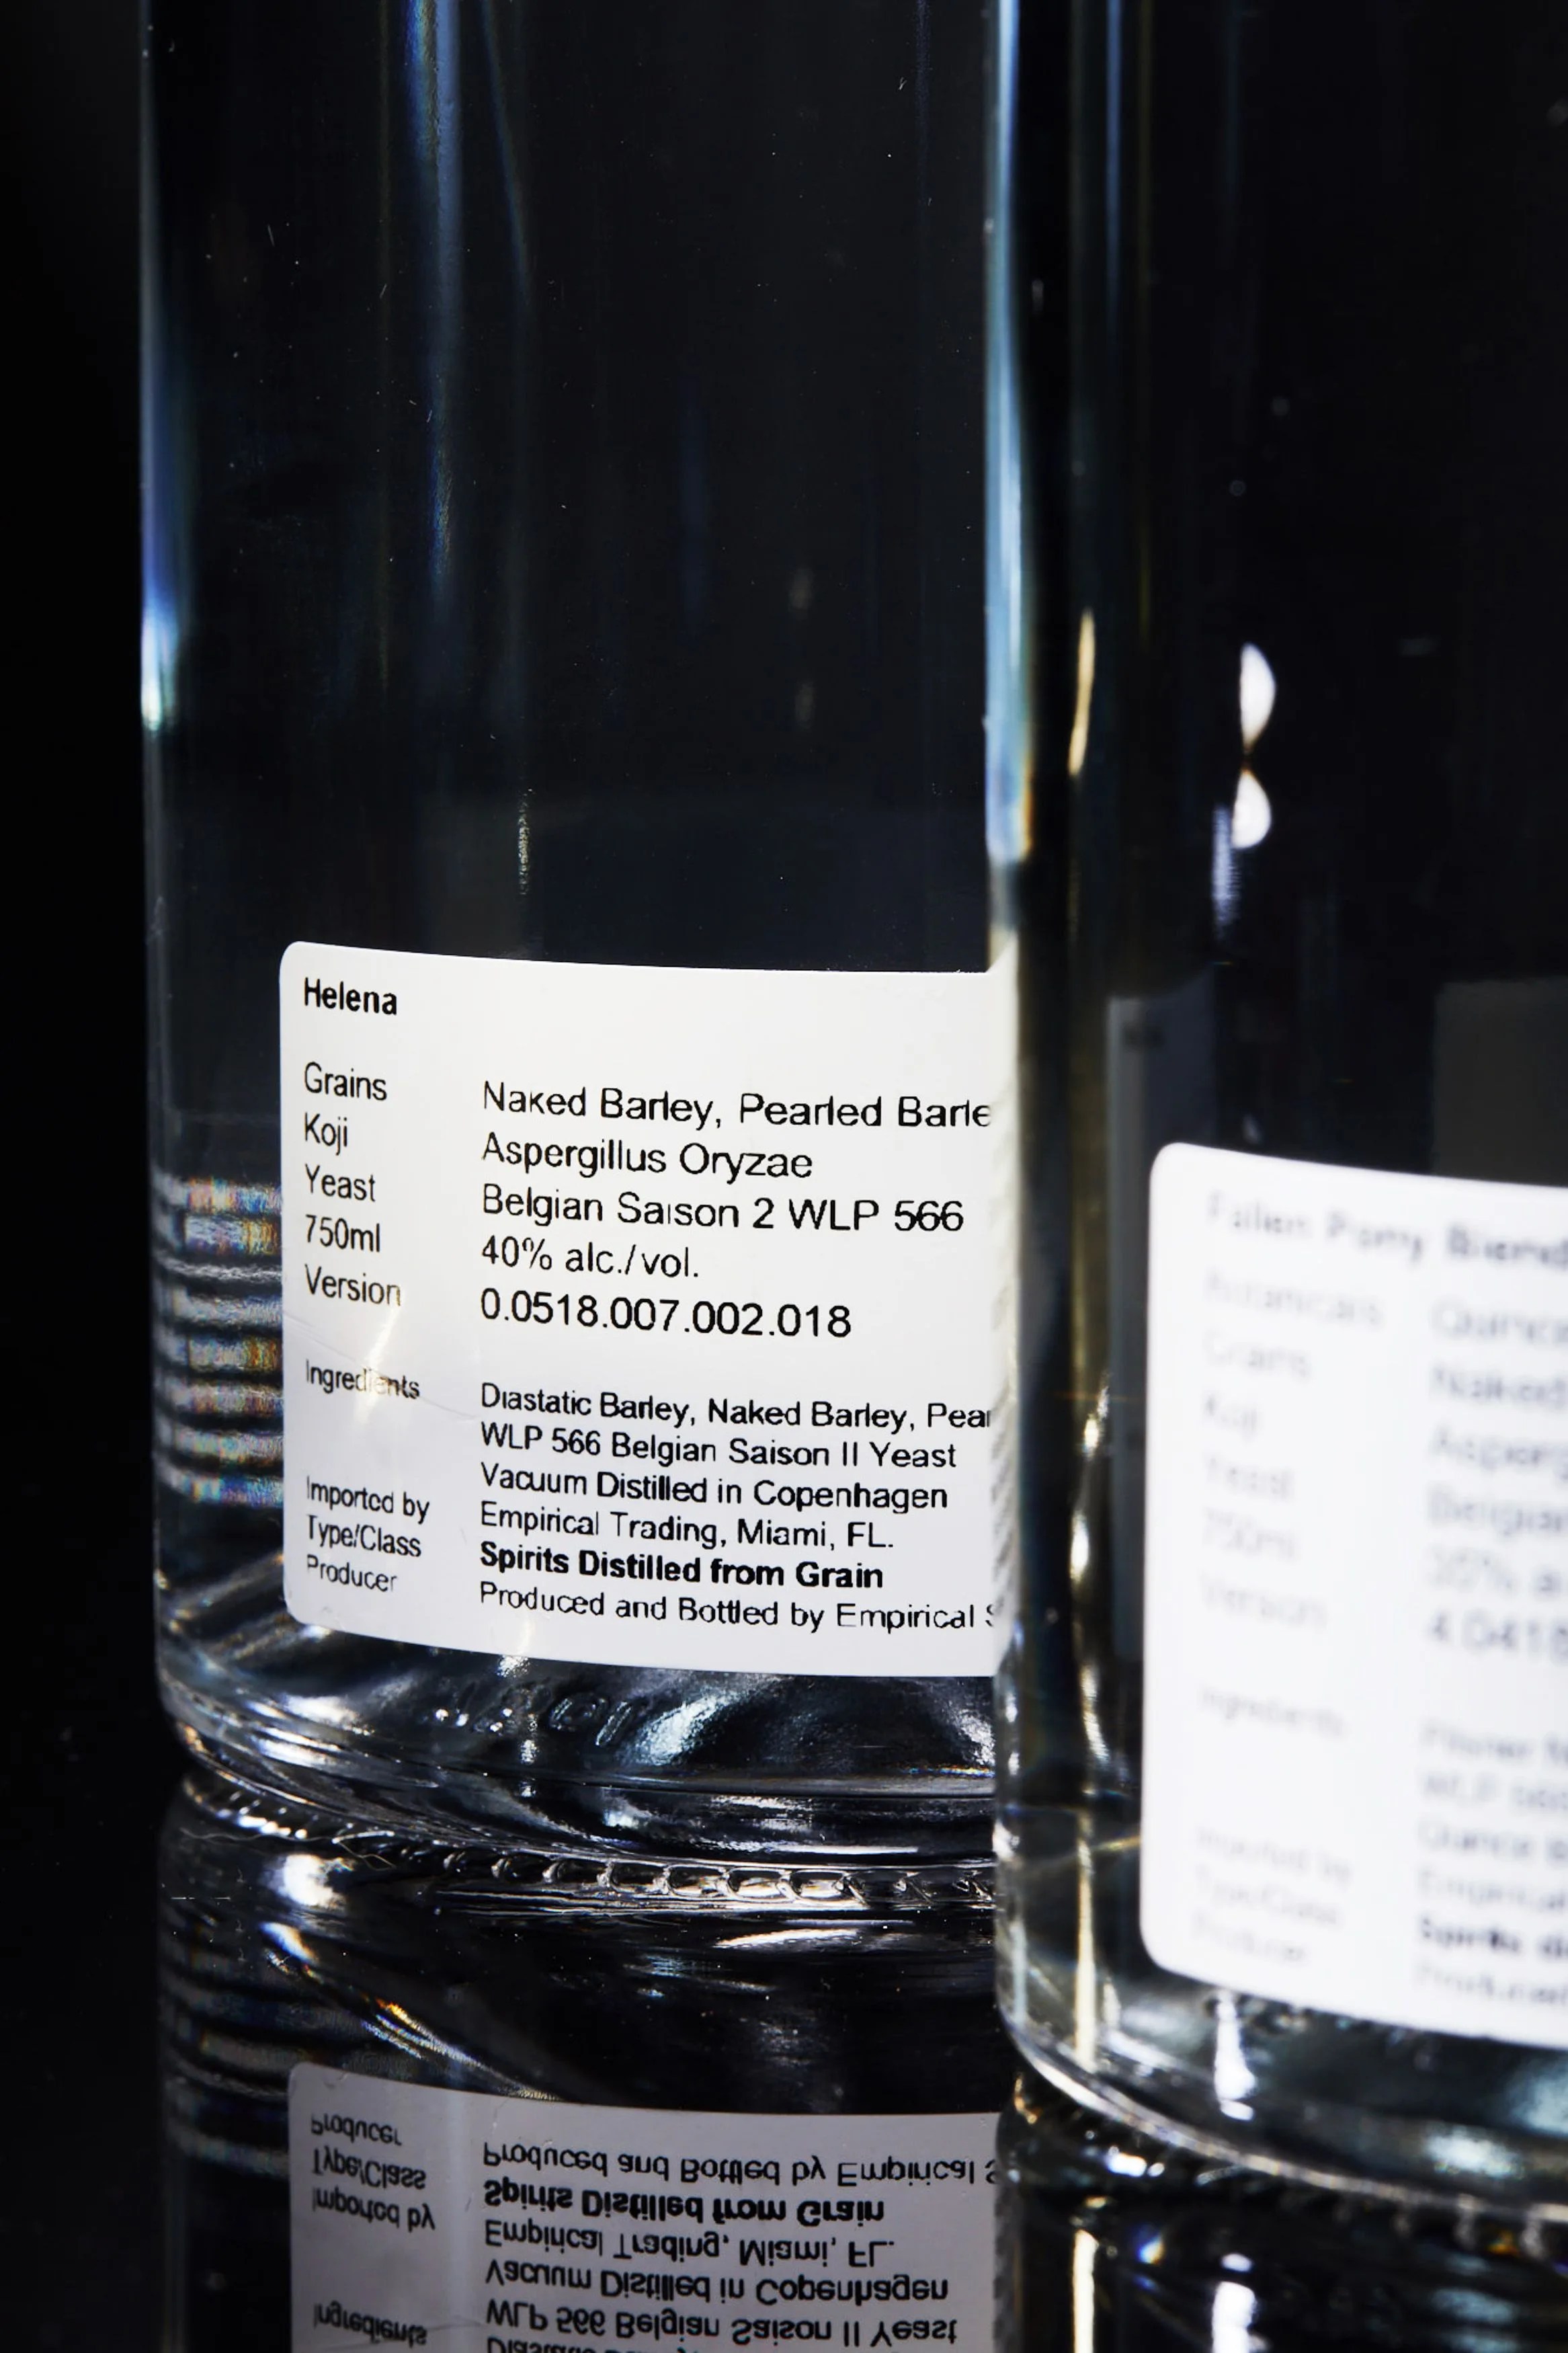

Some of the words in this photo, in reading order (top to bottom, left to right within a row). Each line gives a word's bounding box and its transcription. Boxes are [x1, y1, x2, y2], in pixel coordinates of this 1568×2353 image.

[304, 977, 397, 1015] Helena
[304, 1062, 387, 1101] Grains
[485, 1081, 586, 1116] Naked
[601, 1088, 720, 1131] Barley,
[740, 1093, 881, 1126] Pearled
[899, 1096, 989, 1127] Barle
[304, 1113, 347, 1156] Koji
[483, 1131, 666, 1178] Aspergillus
[679, 1142, 812, 1185] Oryzae
[305, 1164, 375, 1202] Yeast
[483, 1183, 602, 1226] Belgian
[618, 1191, 739, 1228] Saison
[753, 1197, 774, 1229] 2
[789, 1199, 879, 1230] WLP
[895, 1200, 964, 1232] 566
[306, 1214, 380, 1252] 750ml
[482, 1235, 552, 1270] 40%
[305, 1264, 400, 1306] Version
[481, 1288, 851, 1338] 0.0518.007.002.018
[482, 1382, 591, 1416] Diastatic
[600, 1392, 695, 1429] Barley,
[708, 1398, 800, 1426] Naked
[812, 1401, 914, 1435] Barley,
[481, 1421, 542, 1449] WLP
[552, 1428, 600, 1455] 566
[612, 1431, 716, 1468] Belgian
[729, 1438, 829, 1466] Saison
[843, 1441, 858, 1466] II
[869, 1441, 956, 1468] Yeast
[403, 1492, 429, 1525] by
[481, 1462, 587, 1495] Vacuum
[597, 1472, 707, 1503] Distilled
[718, 1478, 741, 1504] in
[754, 1480, 947, 1514] Copenhagen
[308, 1515, 421, 1557] Type/Class
[481, 1501, 599, 1536] Empirical
[610, 1511, 726, 1550] Trading,
[738, 1519, 834, 1551] Miami,
[848, 1522, 893, 1548] FL.
[307, 1554, 397, 1592] Producer
[481, 1541, 569, 1573] Spirits
[579, 1550, 700, 1583] Distilled
[710, 1558, 784, 1586] from
[796, 1561, 882, 1588] Grain
[481, 1581, 604, 1616] Produced
[616, 1596, 666, 1620] and
[679, 1597, 778, 1626] Bottled
[791, 1602, 825, 1633] by
[837, 1603, 974, 1634] Empirical
